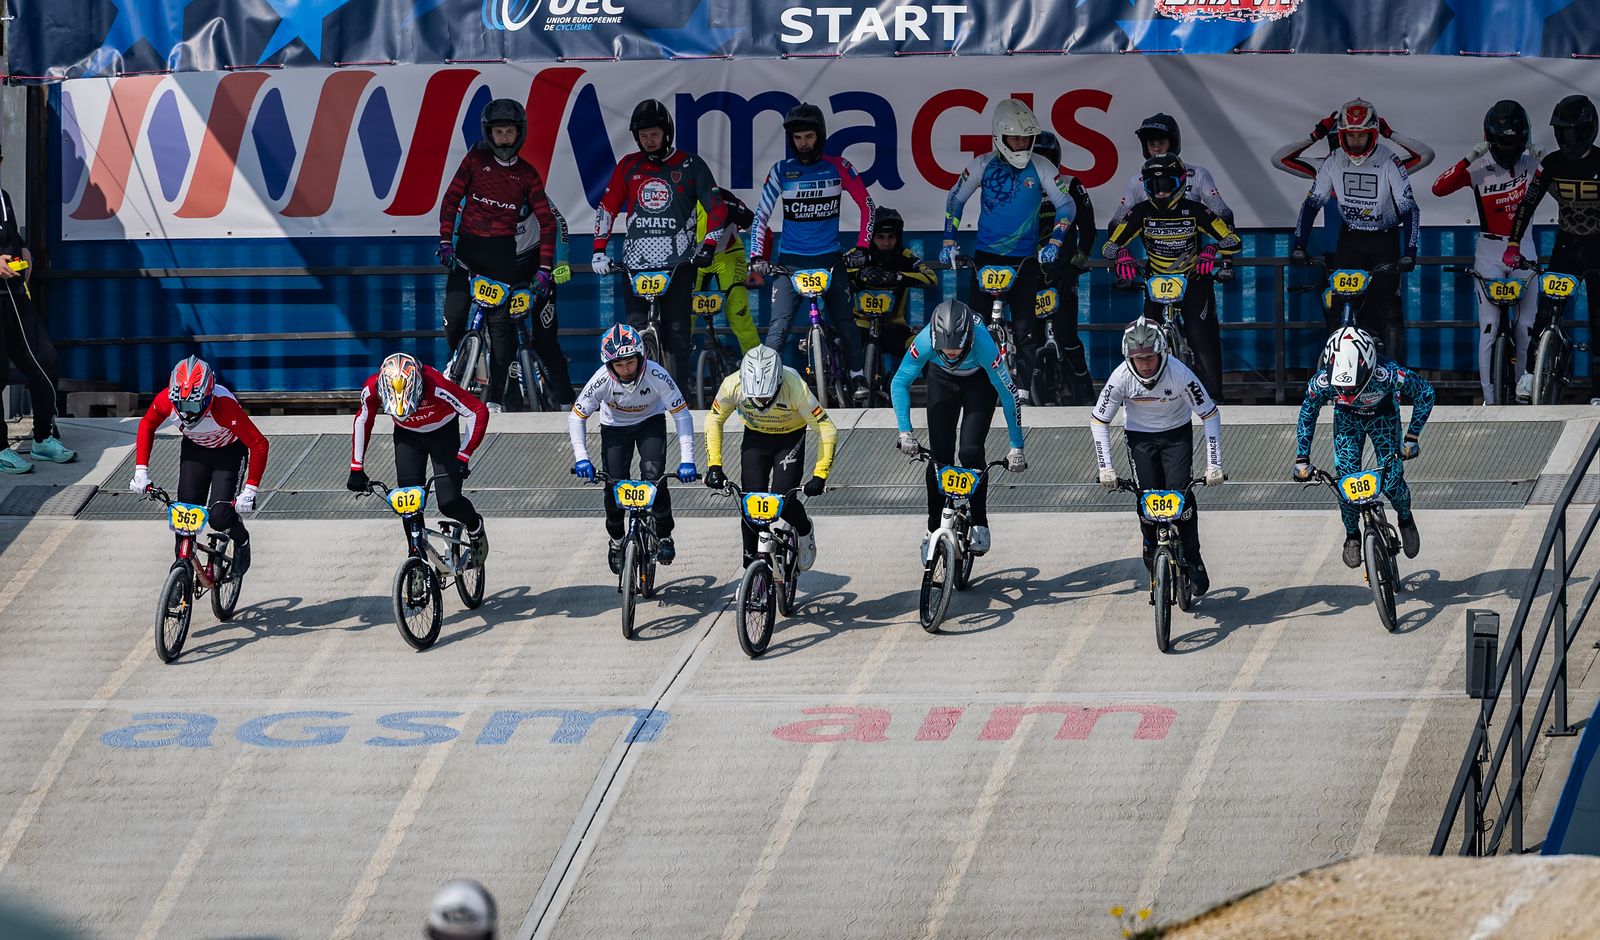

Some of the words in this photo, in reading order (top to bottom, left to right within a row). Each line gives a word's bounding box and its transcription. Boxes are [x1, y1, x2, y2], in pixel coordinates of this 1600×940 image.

[780, 5, 968, 43] START
[675, 88, 1119, 190] maGS
[644, 191, 668, 201] BMX
[797, 190, 823, 198] AVENIR
[472, 193, 516, 210] LATVIA
[636, 217, 676, 229] SMAFC
[641, 279, 660, 290] 615
[802, 276, 821, 287] 553
[987, 273, 1006, 284] 617
[1339, 277, 1358, 288] 643
[478, 284, 498, 299] 605
[1160, 282, 1173, 293] 02
[1495, 285, 1515, 296] 604
[1548, 279, 1568, 292] 025
[697, 298, 716, 309] 640
[1187, 380, 1205, 406] KTM
[406, 411, 436, 422] TRIA
[1208, 435, 1217, 465] BIORACER
[947, 475, 967, 489] 518
[1350, 479, 1371, 495] 588
[397, 494, 416, 508] 612
[624, 489, 645, 501] 608
[756, 500, 769, 513] 16
[1152, 499, 1173, 511] 584
[177, 511, 198, 526] 563
